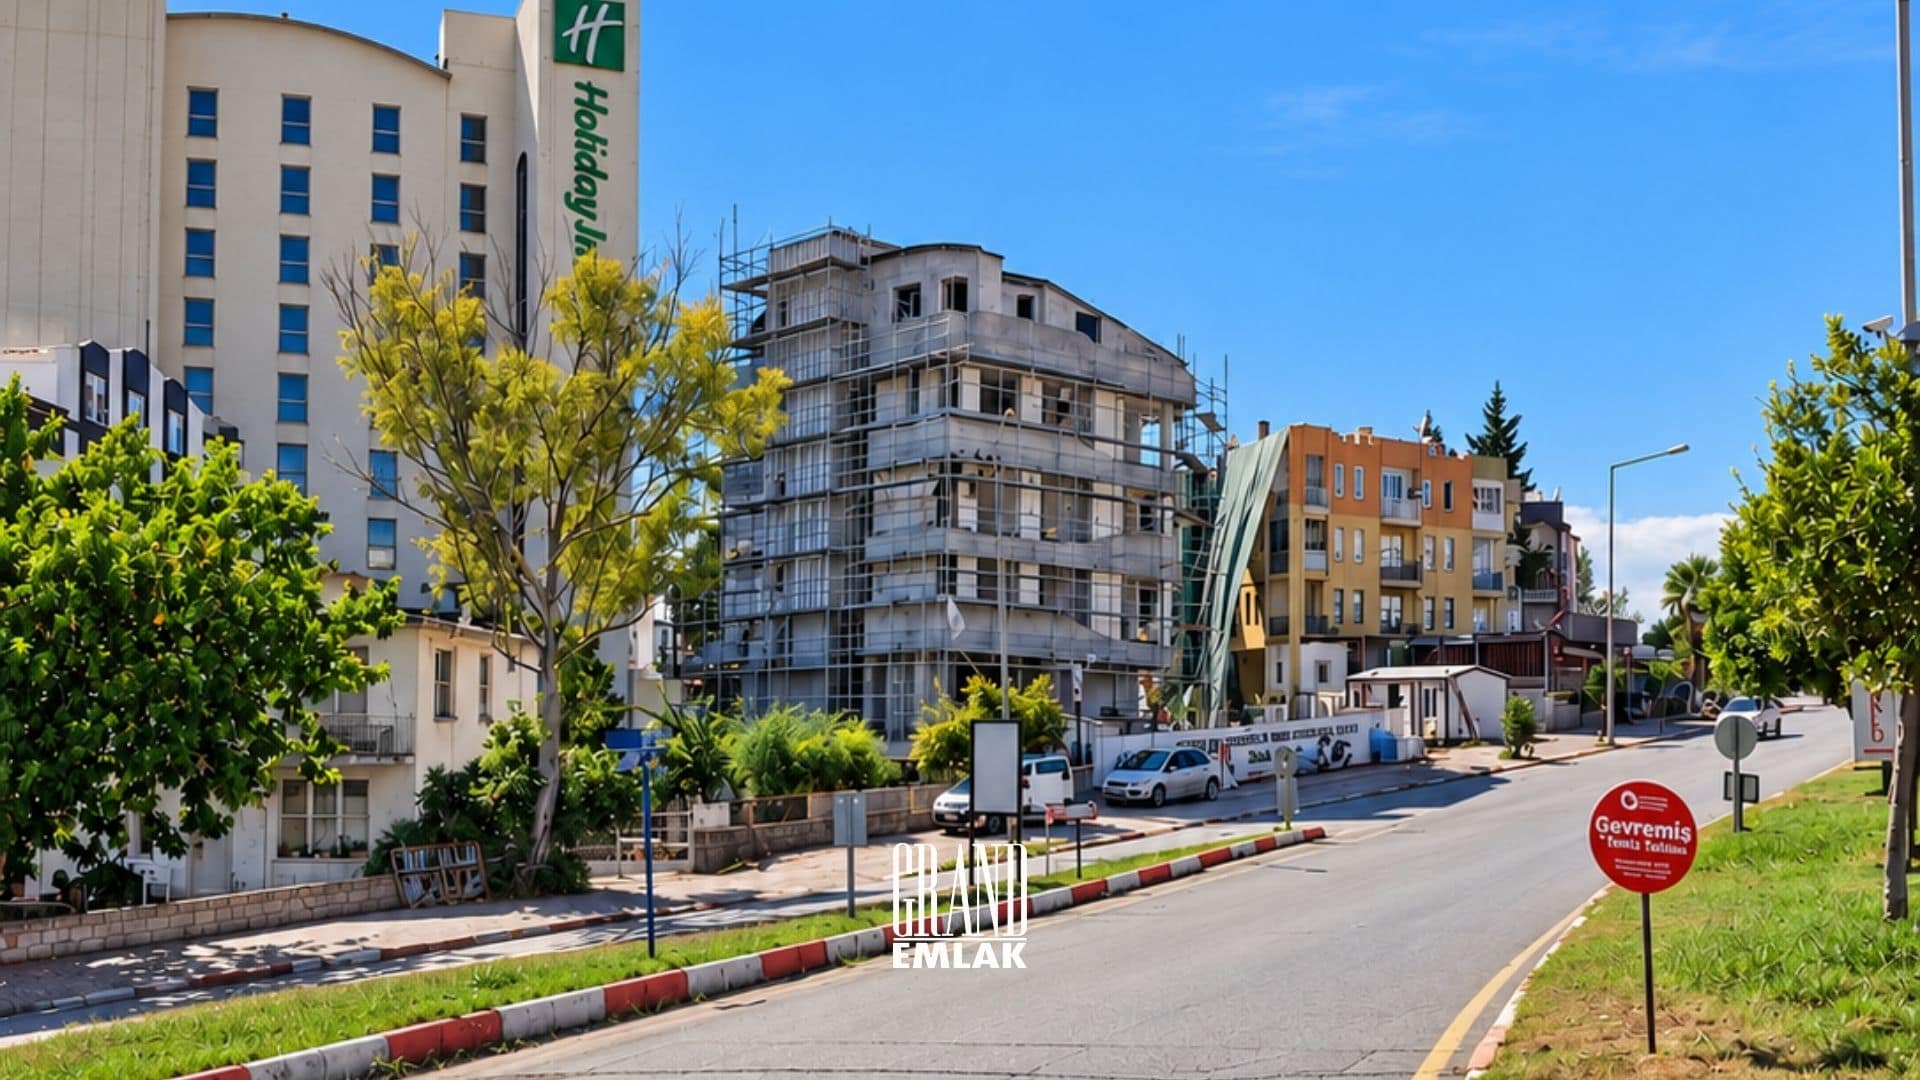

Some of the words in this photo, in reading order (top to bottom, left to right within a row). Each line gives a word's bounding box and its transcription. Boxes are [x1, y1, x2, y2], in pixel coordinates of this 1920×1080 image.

[562, 3, 623, 64] H
[564, 81, 609, 221] Holiday
[574, 218, 607, 257] In
